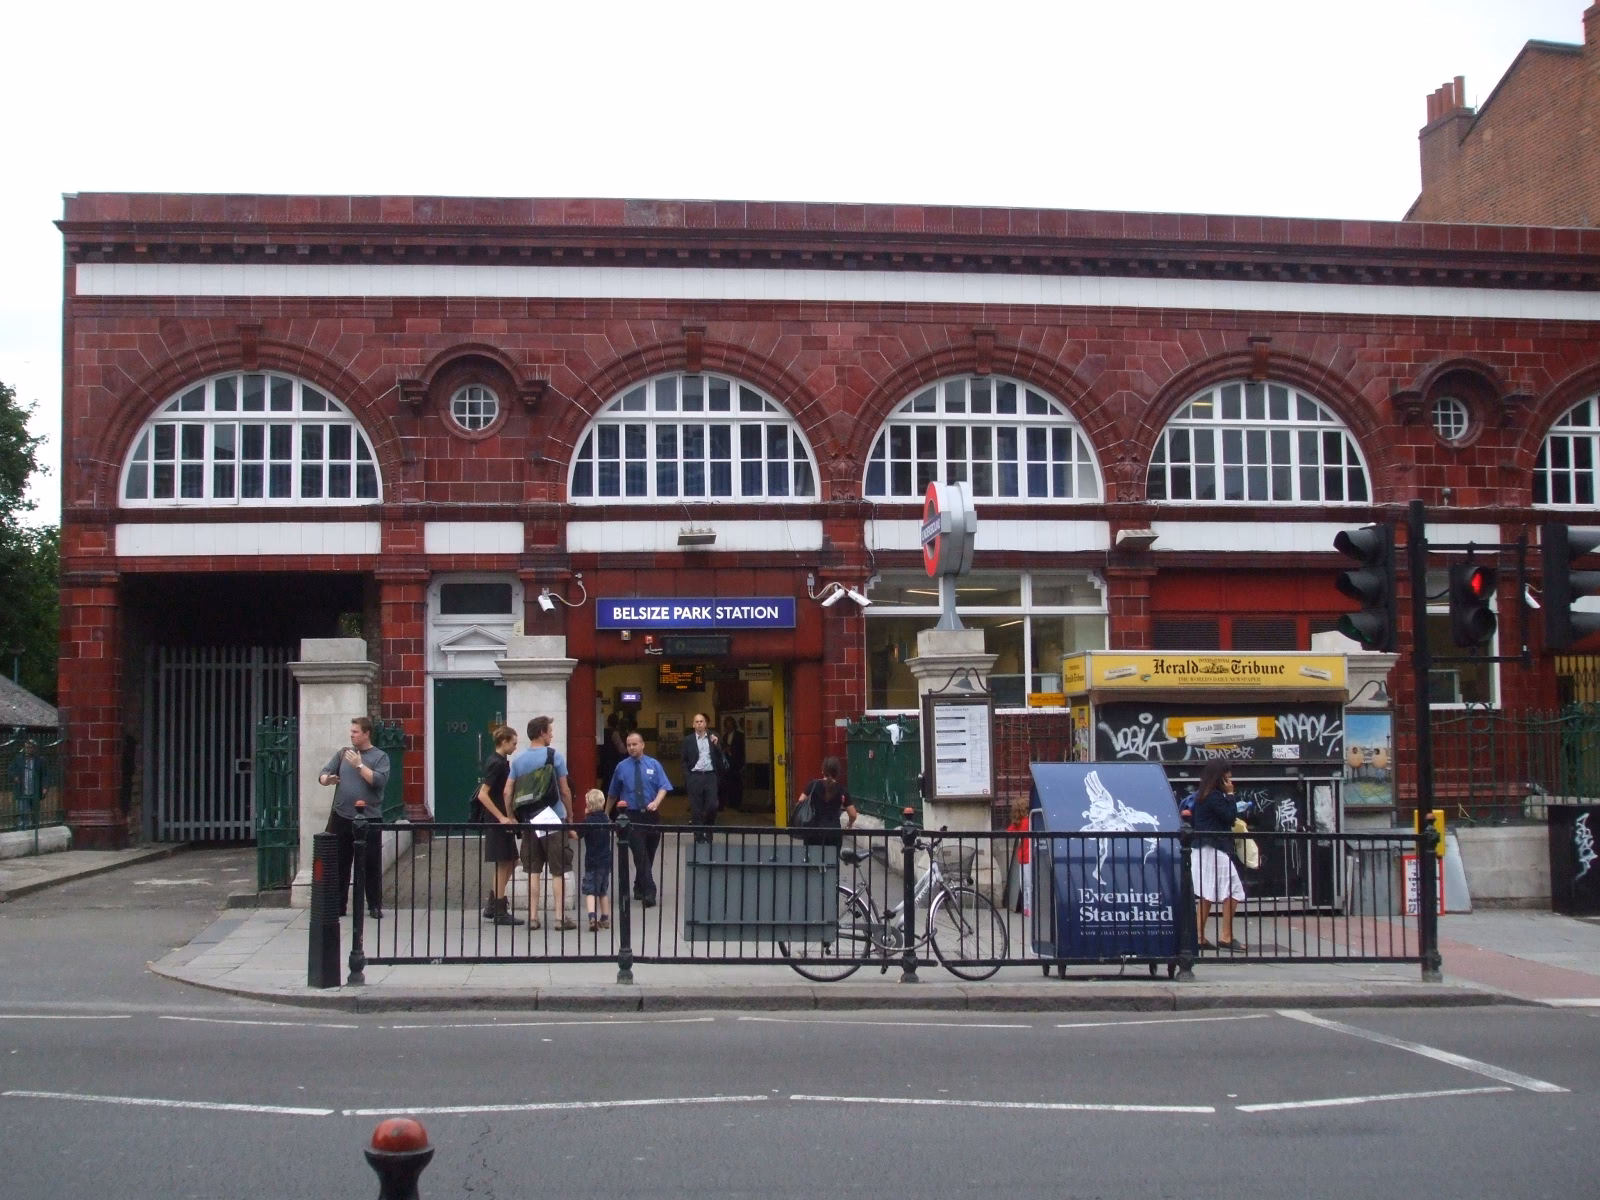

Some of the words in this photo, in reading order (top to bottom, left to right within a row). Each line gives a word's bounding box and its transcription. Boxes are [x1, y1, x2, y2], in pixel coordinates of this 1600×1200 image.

[613, 607, 670, 620] BELSIZE
[673, 606, 712, 620] PARK
[716, 606, 779, 619] STATION
[1153, 659, 1199, 675] Herald
[1231, 660, 1285, 675] Tribune
[1078, 888, 1162, 907] Evening
[1080, 906, 1174, 922] Standard
